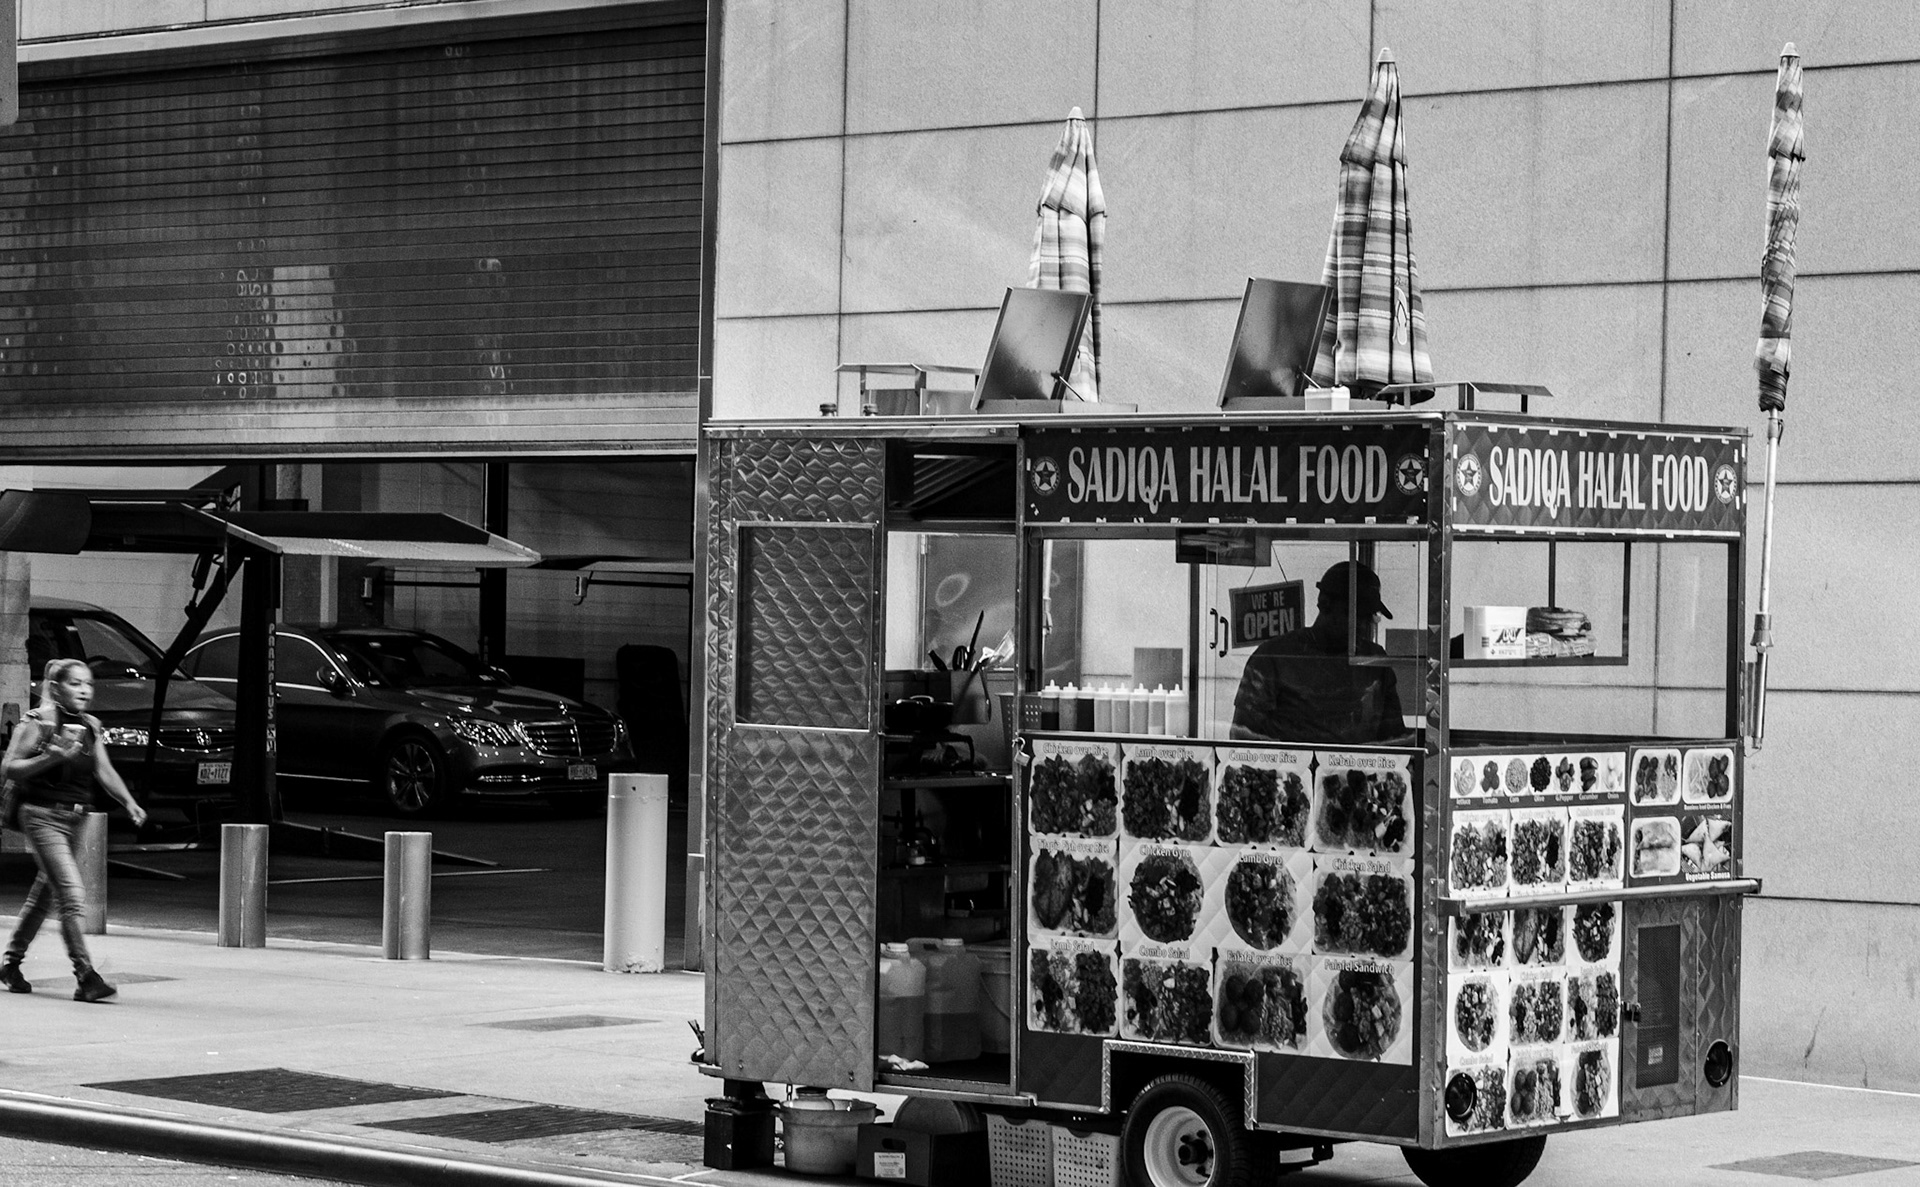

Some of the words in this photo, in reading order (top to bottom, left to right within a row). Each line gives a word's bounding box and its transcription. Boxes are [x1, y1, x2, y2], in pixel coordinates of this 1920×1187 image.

[1067, 445, 1179, 514] SADIQA
[1189, 445, 1288, 503] HALAL
[1299, 443, 1389, 504] FOOD
[1488, 445, 1572, 519] SADIQA
[1578, 450, 1646, 510] HALAL
[1652, 454, 1709, 512] FOOD
[1244, 607, 1295, 640] OPEN
[1042, 742, 1073, 755] Chicken
[1074, 745, 1091, 755] over
[1135, 746, 1158, 758] Lamb
[1158, 749, 1177, 759] over
[1177, 747, 1195, 760] Rice
[1229, 749, 1259, 762] Combo
[1259, 753, 1279, 763] over
[1279, 751, 1298, 764] Rice
[1328, 754, 1355, 767] Kebab
[1356, 757, 1377, 768] over
[1377, 756, 1396, 769] Rice
[1139, 844, 1171, 857] Chicken
[1172, 846, 1192, 860] Gyro
[1239, 850, 1262, 863] Lamb
[1262, 852, 1284, 867] Gyro
[1331, 858, 1366, 871] Chicken
[1366, 860, 1392, 873] Salad
[1050, 938, 1072, 951] Lamb
[1073, 940, 1095, 952] Salad
[1139, 944, 1167, 958] Combo
[1167, 946, 1190, 960] Salad
[1353, 960, 1395, 975] Sandwich
